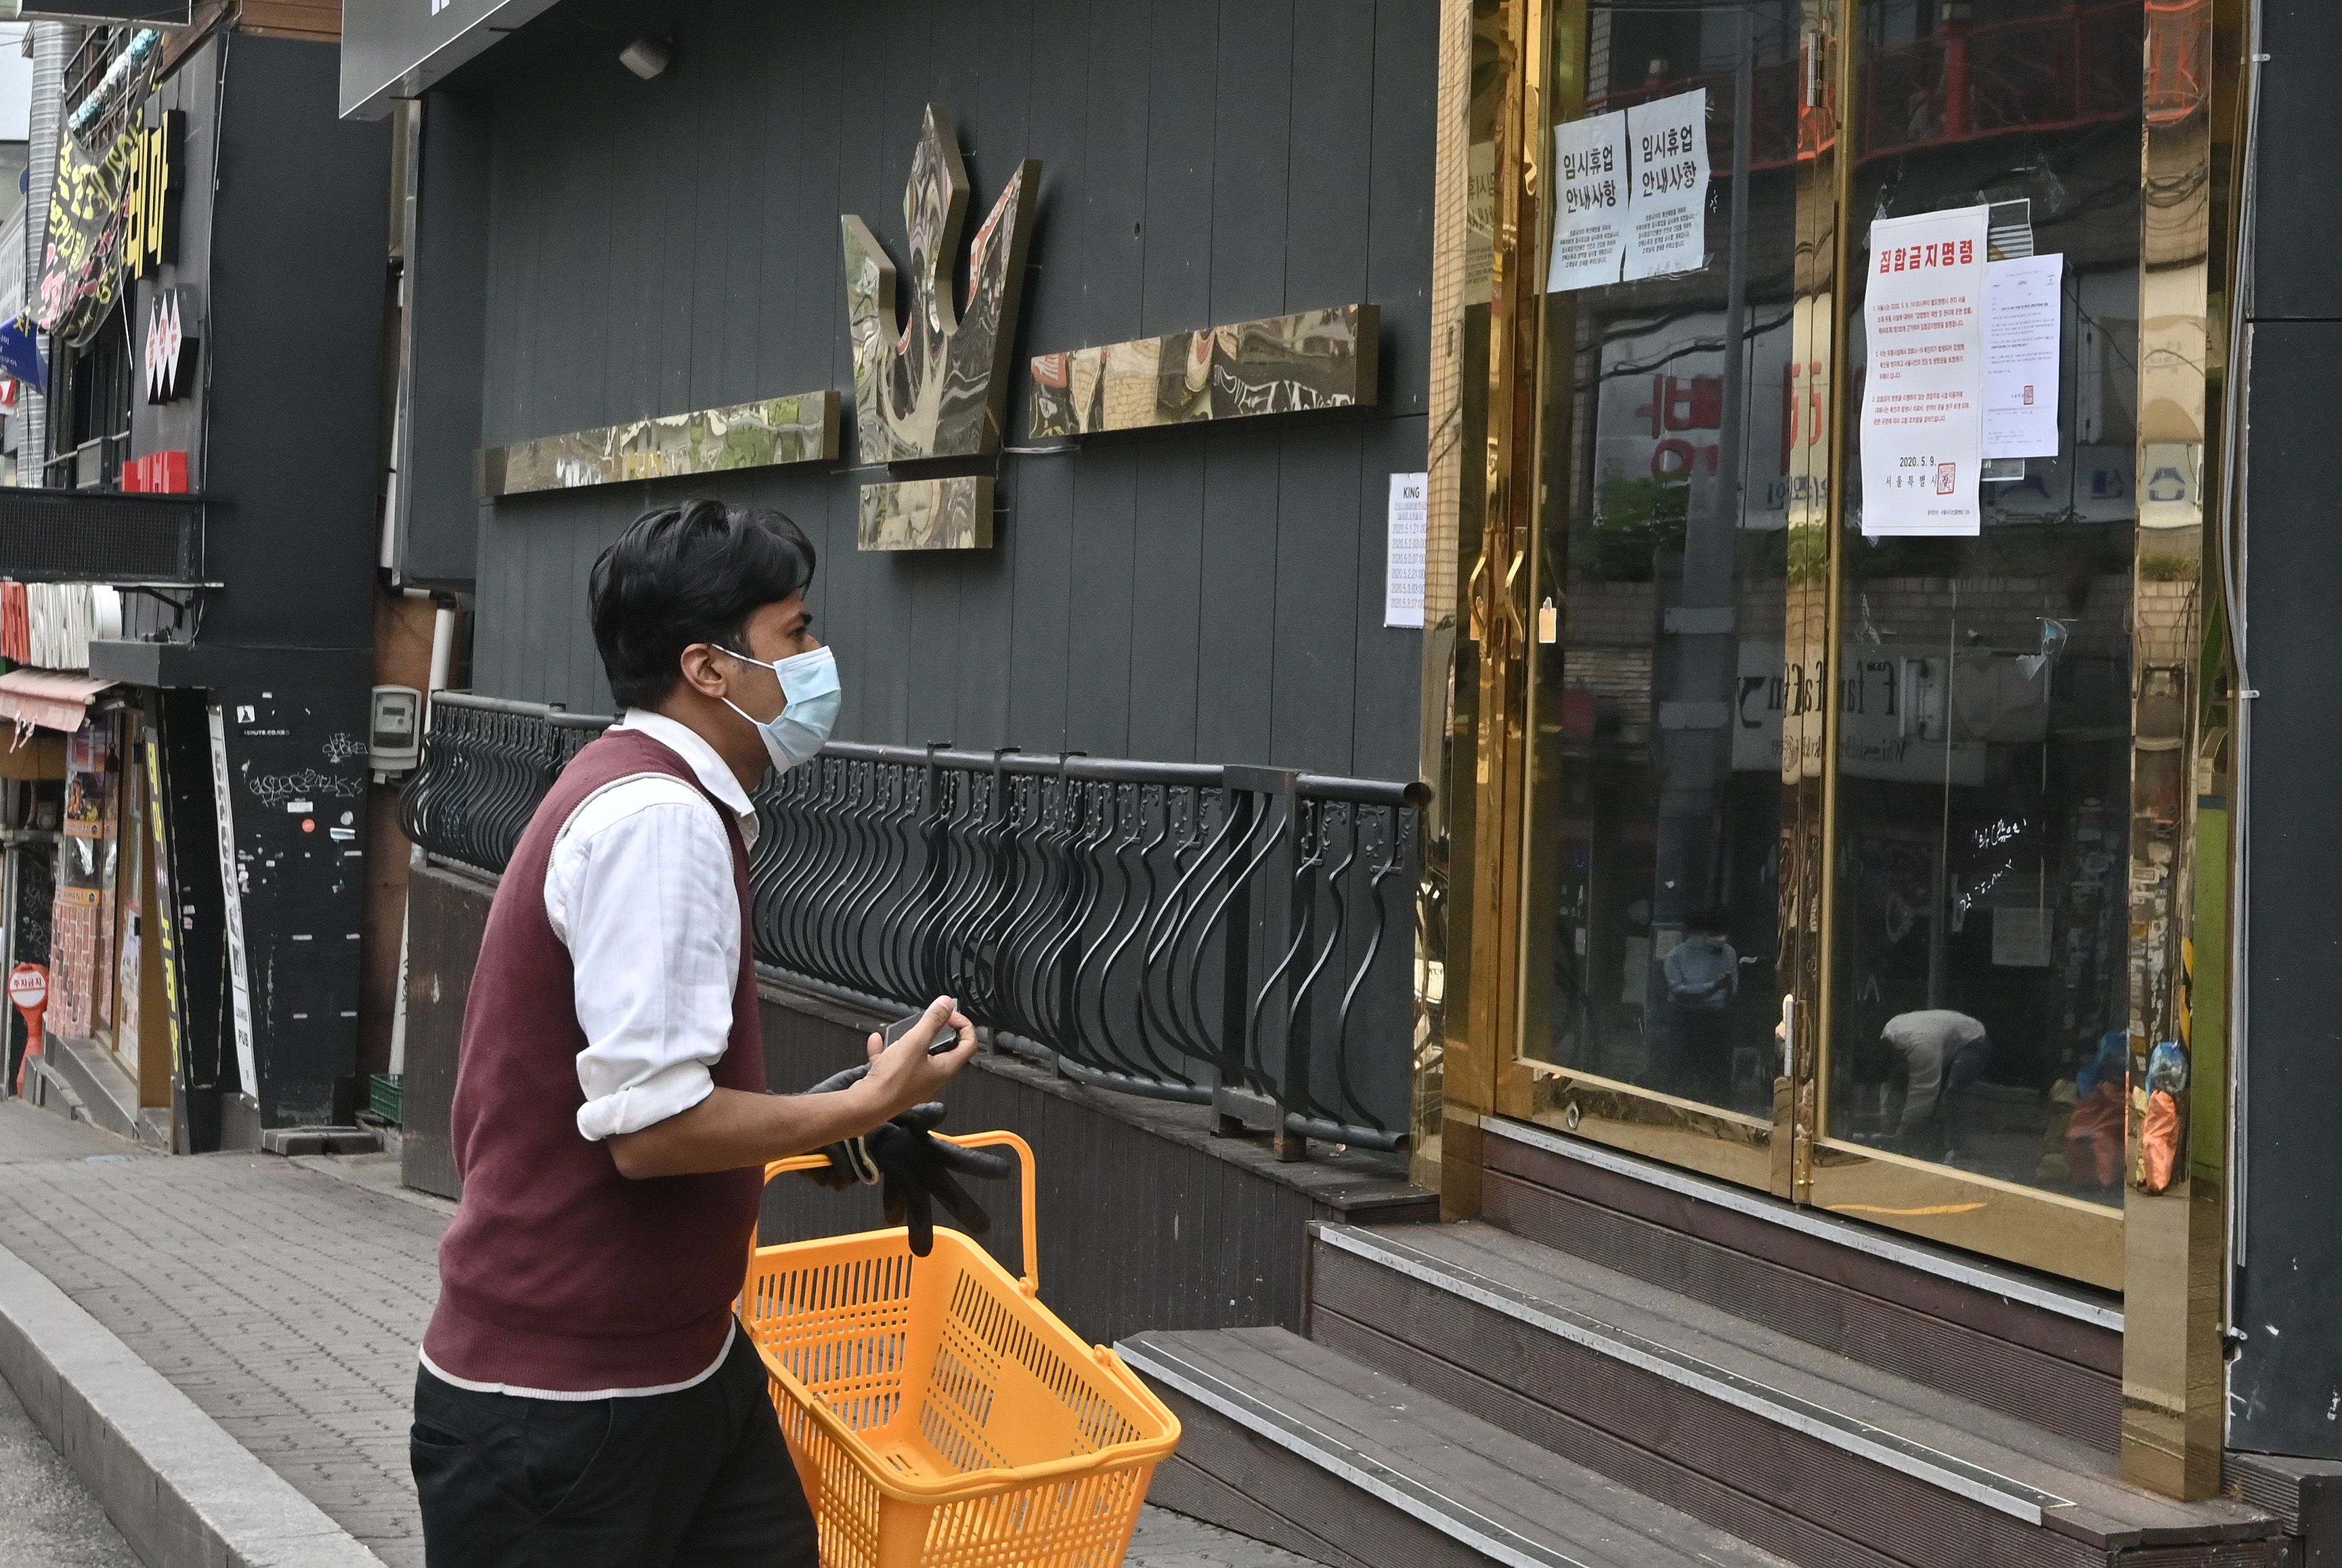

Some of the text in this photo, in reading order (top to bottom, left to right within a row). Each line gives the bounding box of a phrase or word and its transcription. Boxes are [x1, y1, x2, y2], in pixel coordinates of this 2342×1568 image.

[1642, 125, 1693, 162] 임시휴업
[1563, 144, 1613, 180] 임시휴업
[1642, 160, 1696, 198] 안내사항
[1566, 179, 1616, 214] 안내사항
[1880, 240, 1974, 274] 집합금지명령
[1900, 456, 1936, 467] 2020. 5. 9.
[1403, 486, 1420, 499] KING
[238, 1029, 249, 1047] PUB
